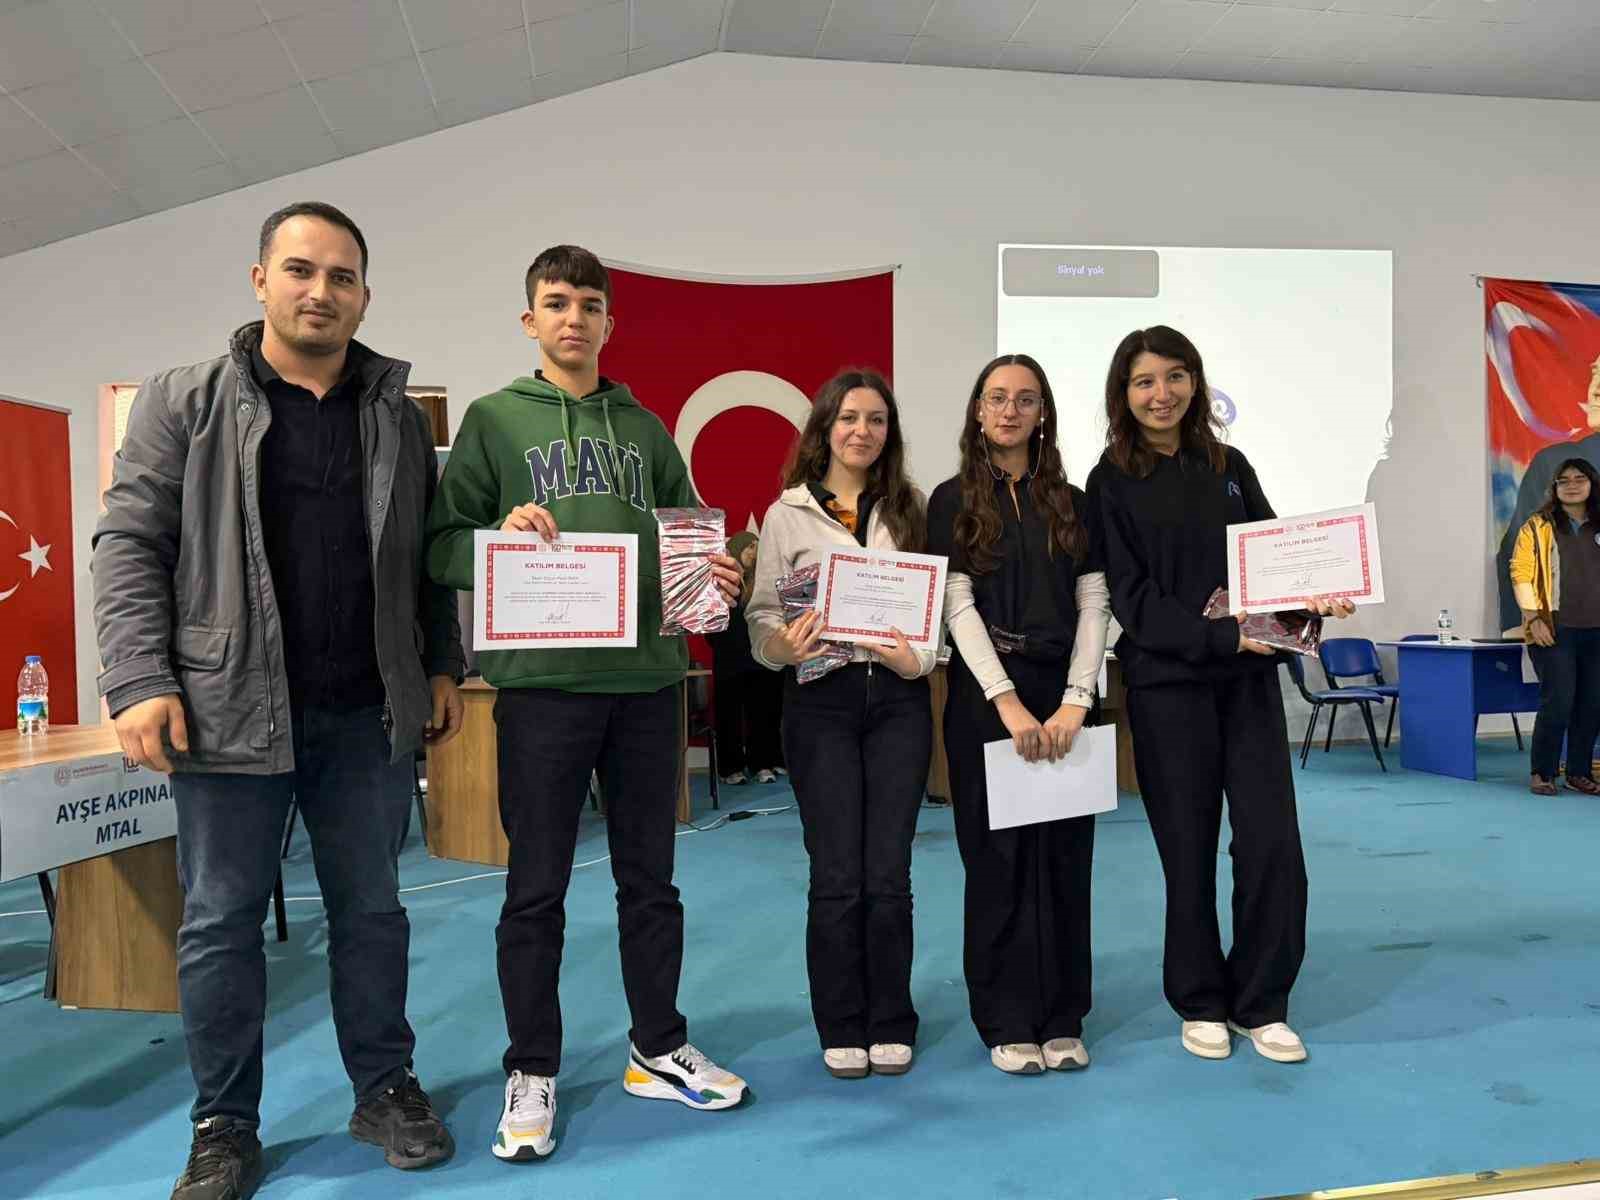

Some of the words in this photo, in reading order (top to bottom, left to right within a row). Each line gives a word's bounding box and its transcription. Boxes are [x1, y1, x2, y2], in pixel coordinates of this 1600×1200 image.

[1087, 264, 1104, 277] yok
[56, 797, 102, 824] AYŞE
[105, 783, 175, 813] AKPINA
[96, 818, 142, 845] MTAL
